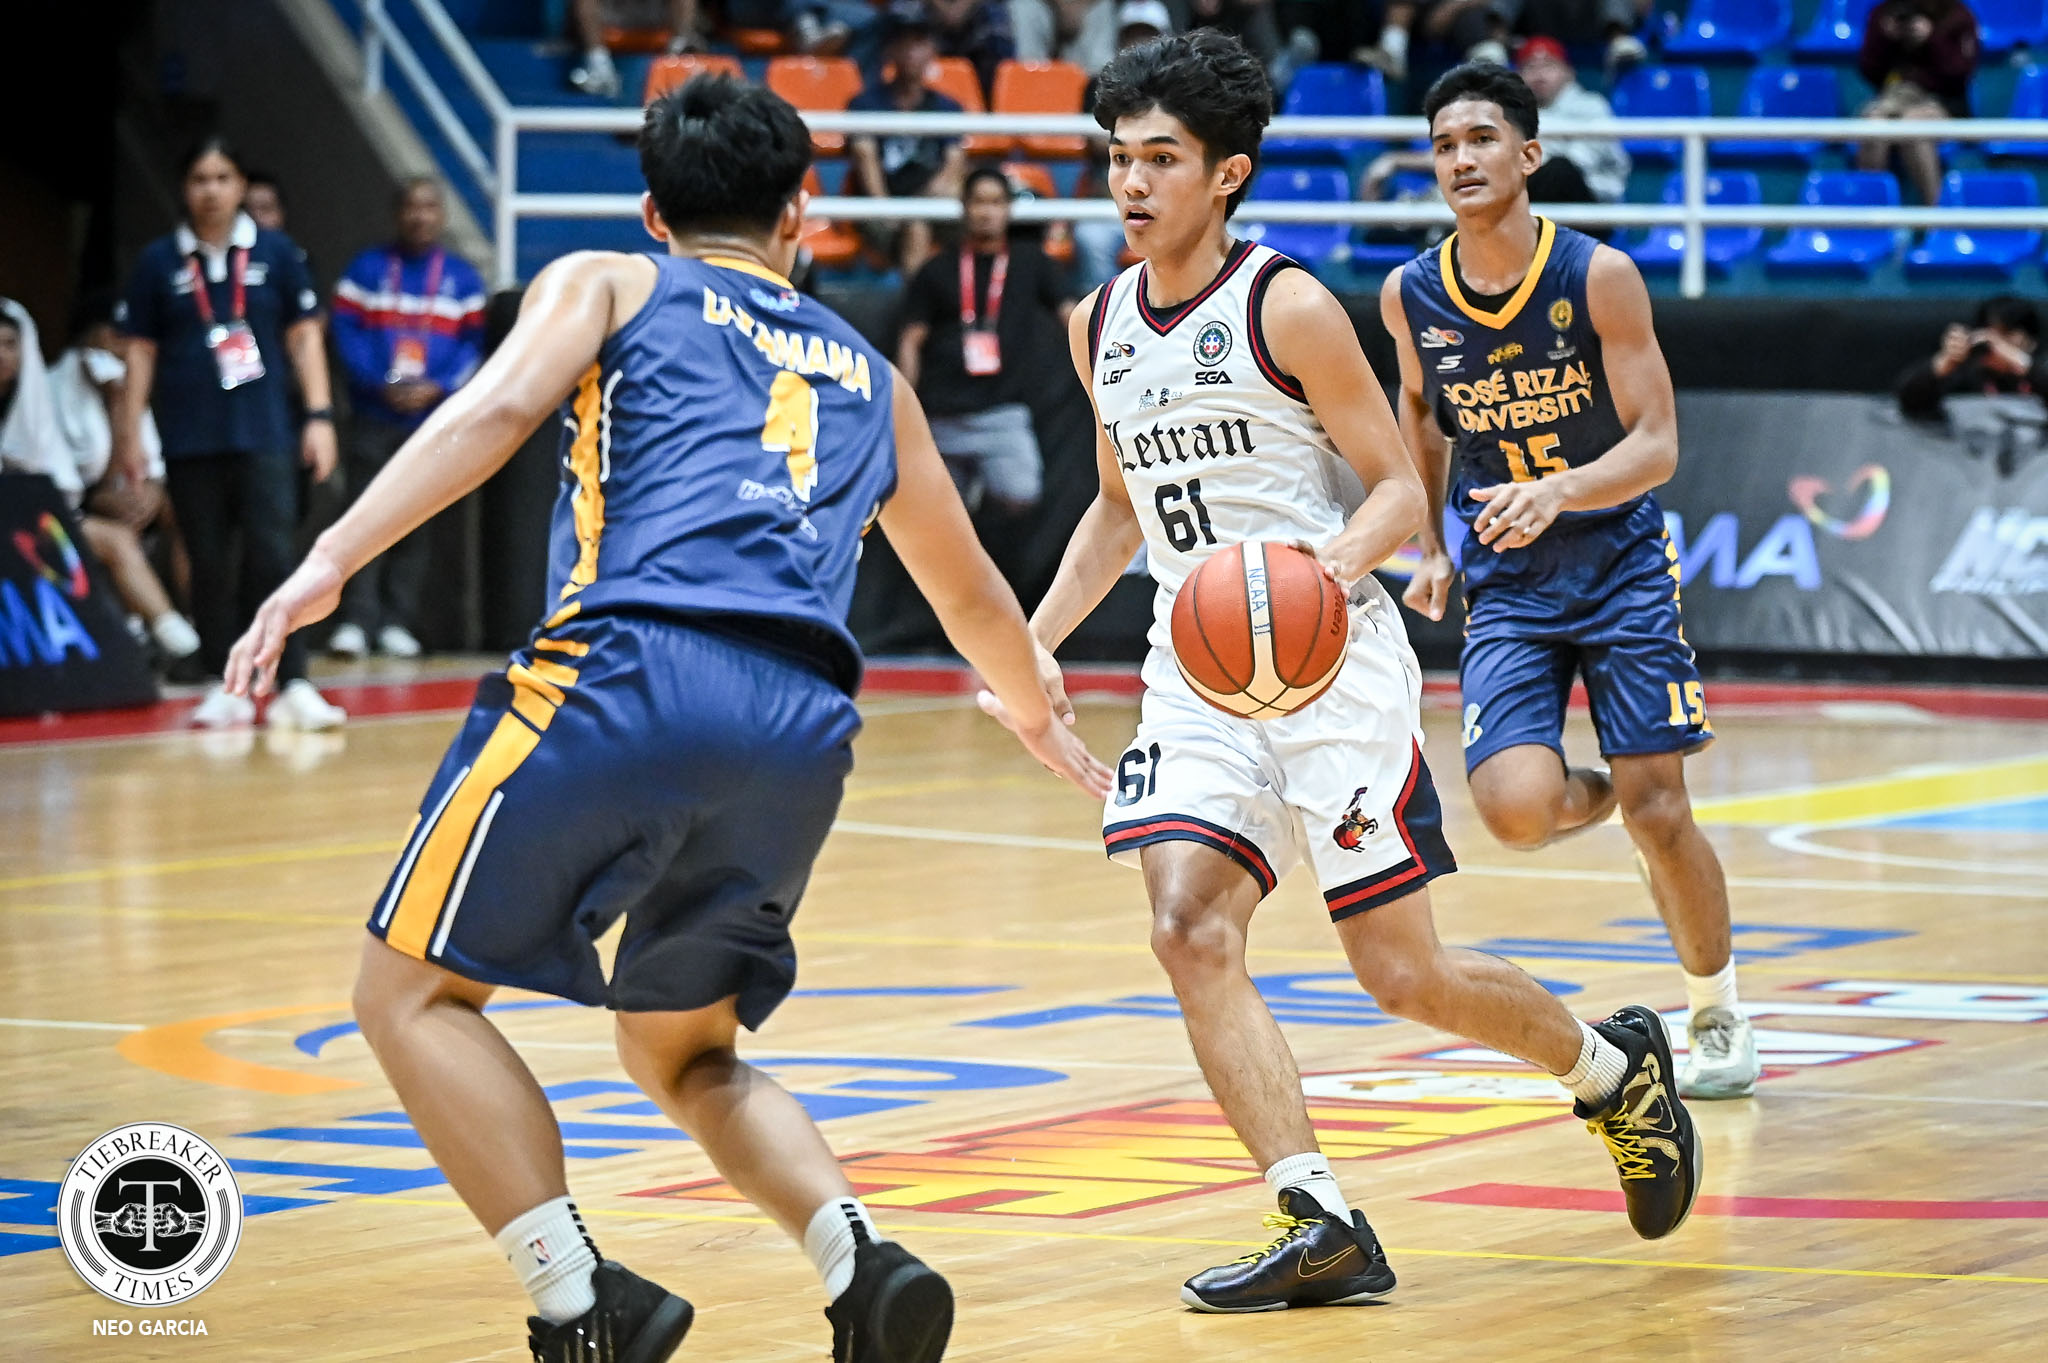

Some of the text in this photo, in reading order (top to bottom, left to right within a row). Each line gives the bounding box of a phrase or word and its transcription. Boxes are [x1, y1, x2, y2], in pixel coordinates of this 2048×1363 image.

[1194, 370, 1233, 386] SGA
[1512, 360, 1592, 398] RIZAL
[1457, 387, 1593, 434] UNIVERSITY
[761, 370, 819, 502] 4
[1104, 418, 1257, 474] Letran
[1498, 432, 1569, 484] 15
[1155, 478, 1218, 553] 61
[1248, 567, 1267, 612] NCAA
[1666, 681, 1704, 726] 15
[1114, 742, 1162, 807] 61
